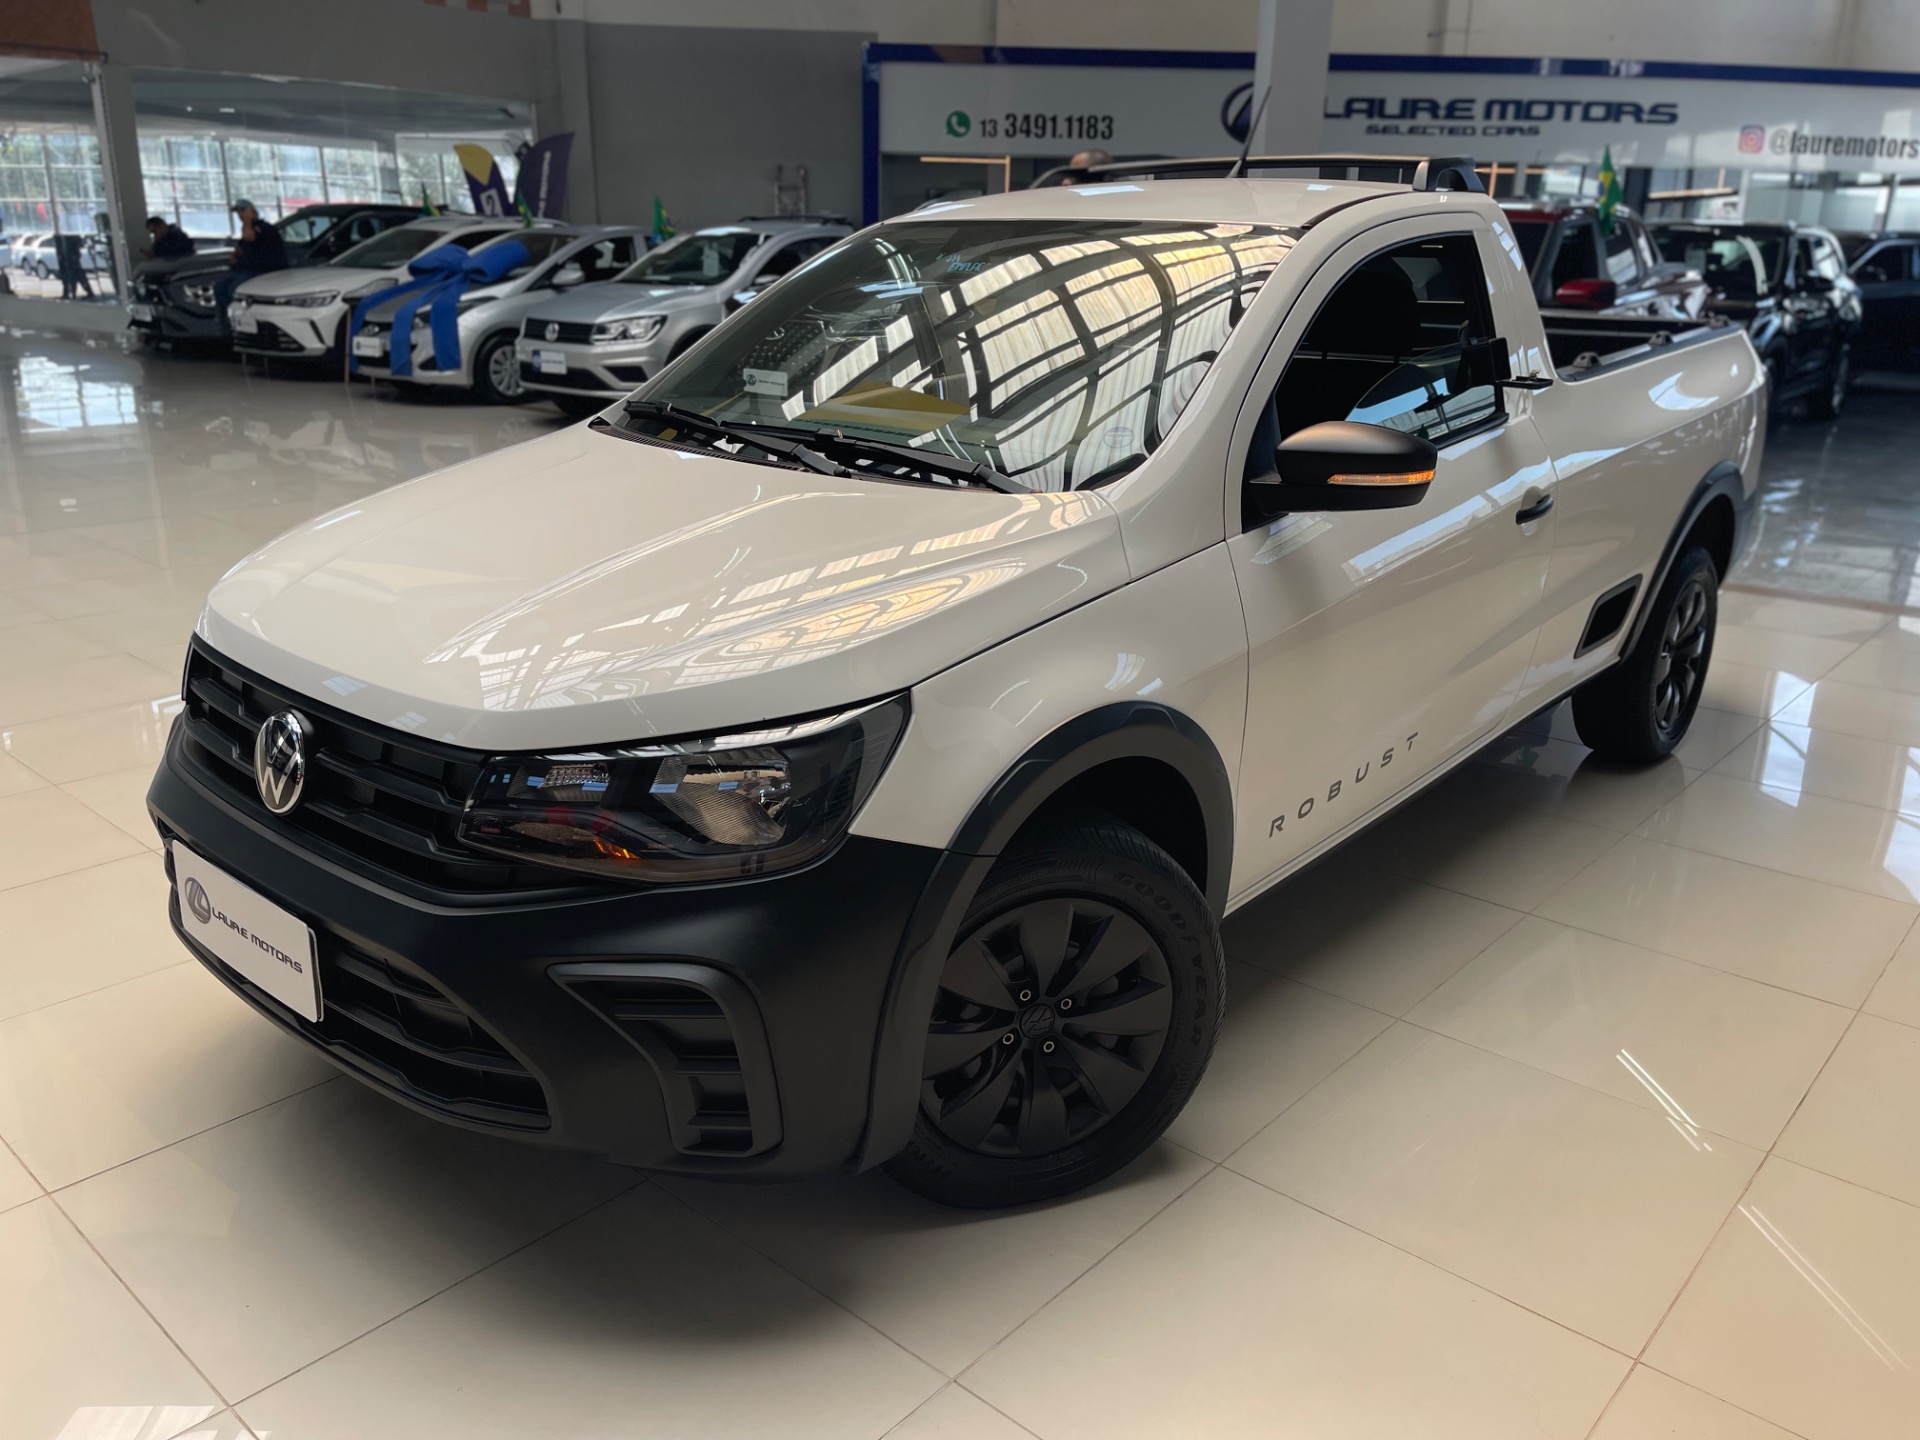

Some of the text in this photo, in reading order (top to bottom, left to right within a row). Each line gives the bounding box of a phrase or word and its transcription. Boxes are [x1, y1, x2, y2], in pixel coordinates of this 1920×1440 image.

[1324, 97, 1679, 124] LAURE MOTORS
[979, 113, 1114, 140] 13 3491.1183
[1365, 124, 1541, 137] SELECTED CARS
[1268, 731, 1419, 838] ROBUST
[212, 907, 303, 974] LAURE MOTORS
